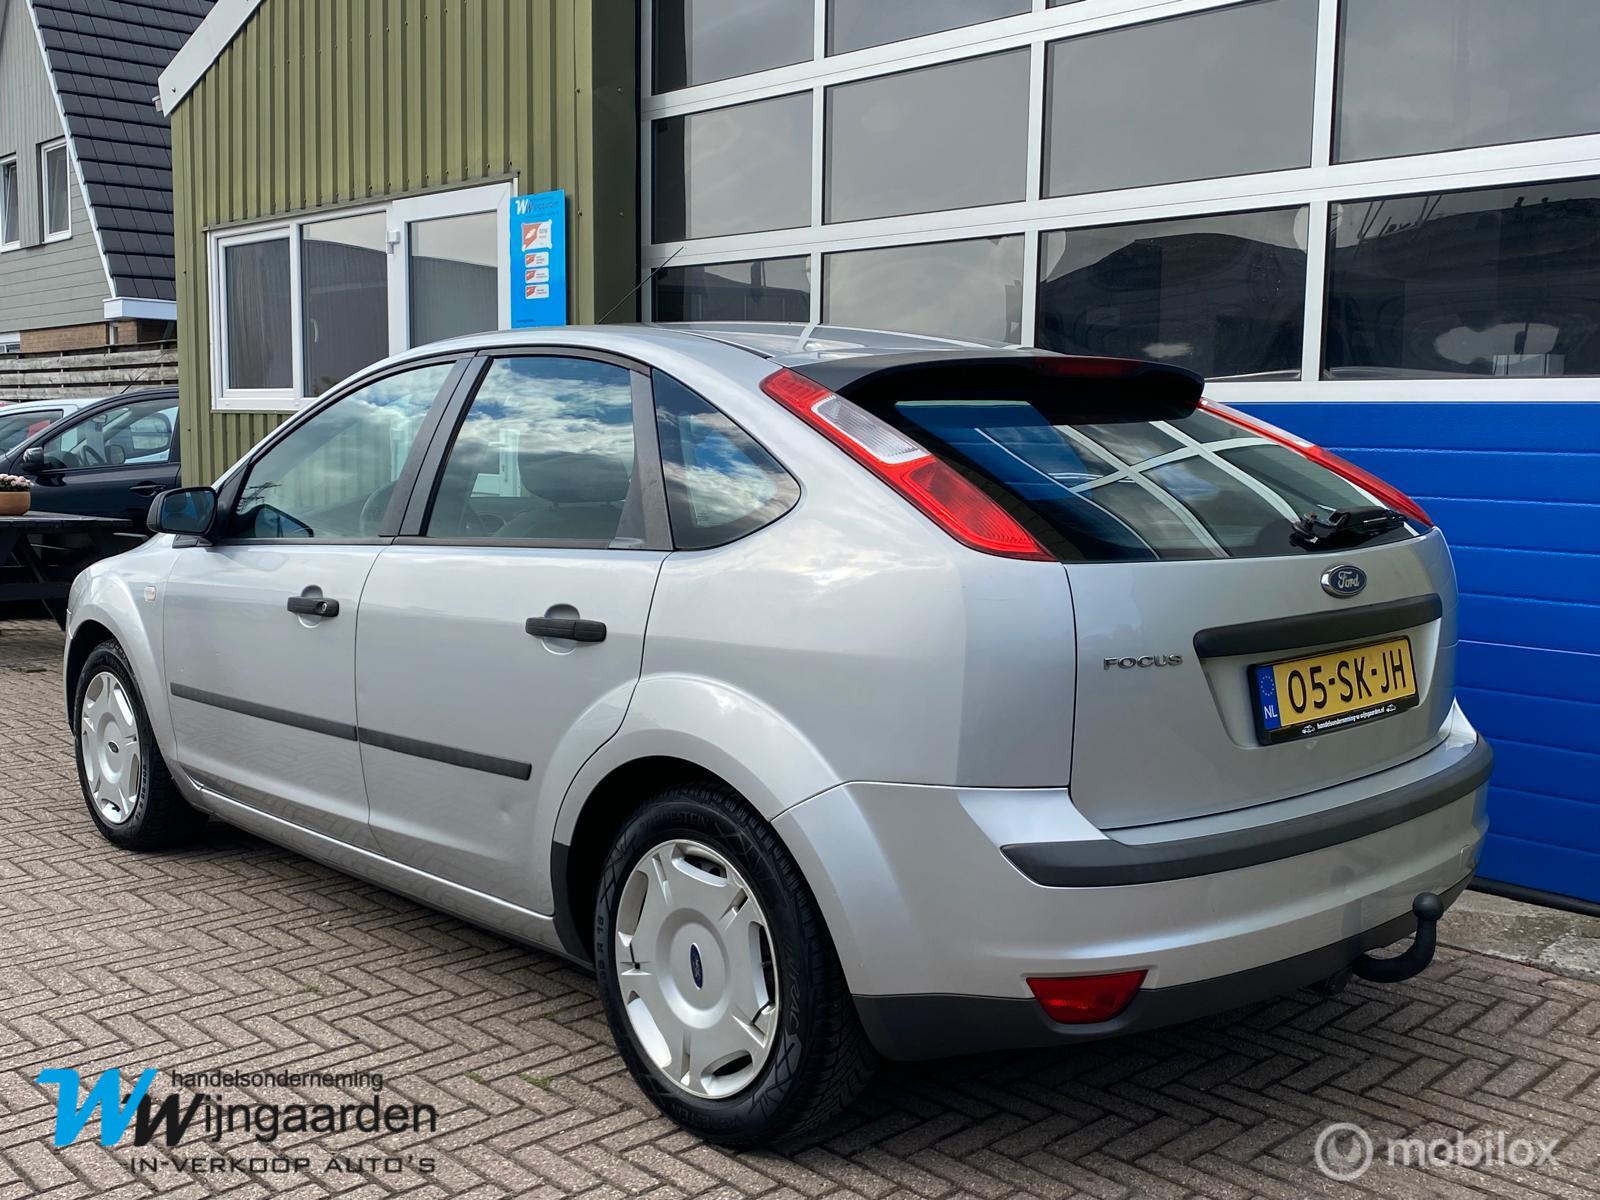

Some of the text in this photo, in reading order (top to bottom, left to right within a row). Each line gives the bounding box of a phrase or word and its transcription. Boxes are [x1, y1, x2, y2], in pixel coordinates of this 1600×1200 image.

[1104, 654, 1183, 671] FOCUS
[1287, 648, 1407, 714] 05-SK-JH
[1263, 705, 1278, 720] NL
